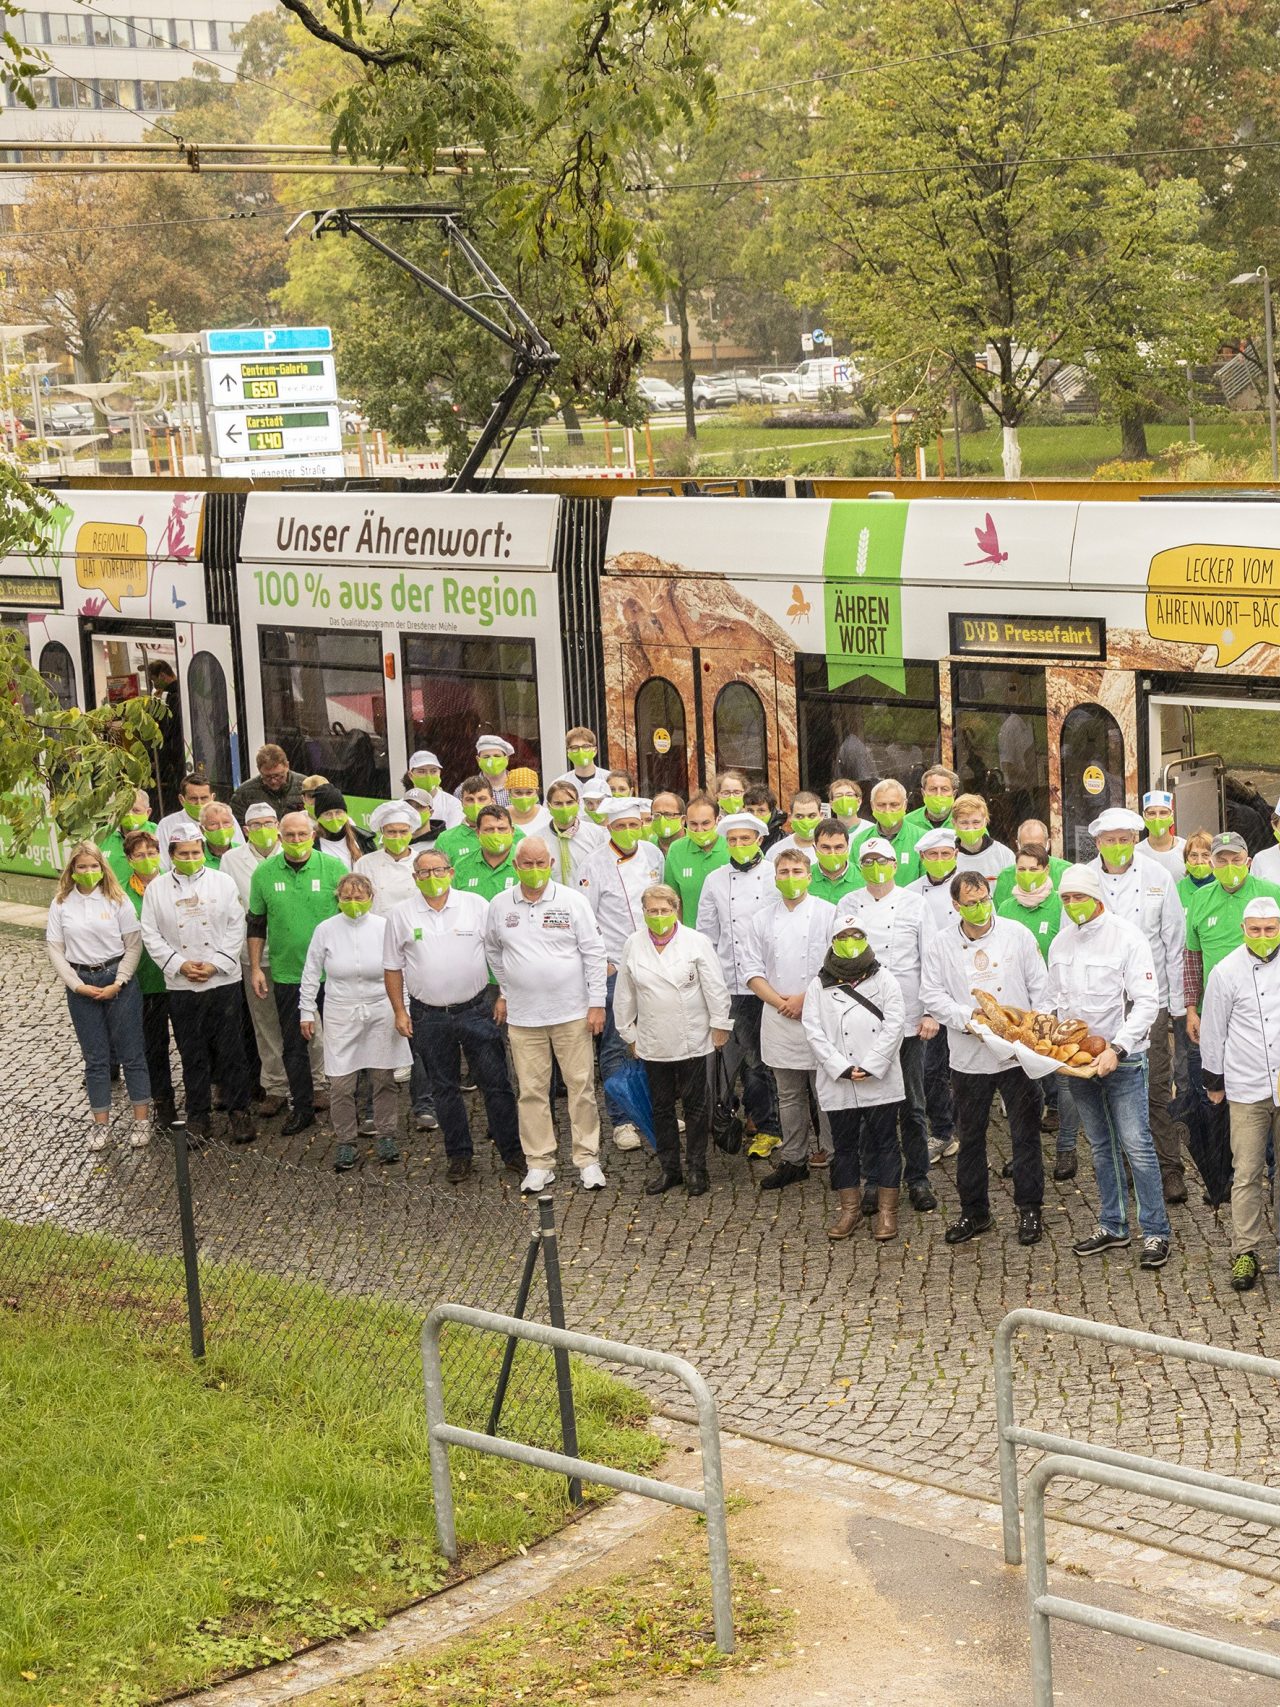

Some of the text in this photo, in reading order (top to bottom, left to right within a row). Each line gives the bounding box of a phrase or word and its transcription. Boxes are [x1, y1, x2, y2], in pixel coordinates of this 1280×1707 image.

[264, 330, 276, 350] P
[242, 363, 308, 376] Centrum-Galerie
[252, 382, 276, 398] 650
[246, 416, 284, 428] Karstadt
[257, 432, 282, 448] 140
[300, 464, 326, 476] Straße
[93, 532, 129, 552] REGIONAL
[276, 510, 512, 558] Unser Ährenwort:
[82, 560, 142, 580] HAT VORFAHRT!
[1186, 556, 1274, 585] LECKER VOM
[6, 582, 58, 597] Pressefahrt
[339, 580, 383, 611] aus
[391, 573, 434, 614] der
[442, 575, 538, 627] Region
[834, 590, 890, 625] ÄHREN
[329, 617, 458, 632] Das Qualitätsprogramm der Dresdener Mühle
[964, 621, 1092, 644] DVB Pressefahrt
[840, 626, 888, 655] WORT
